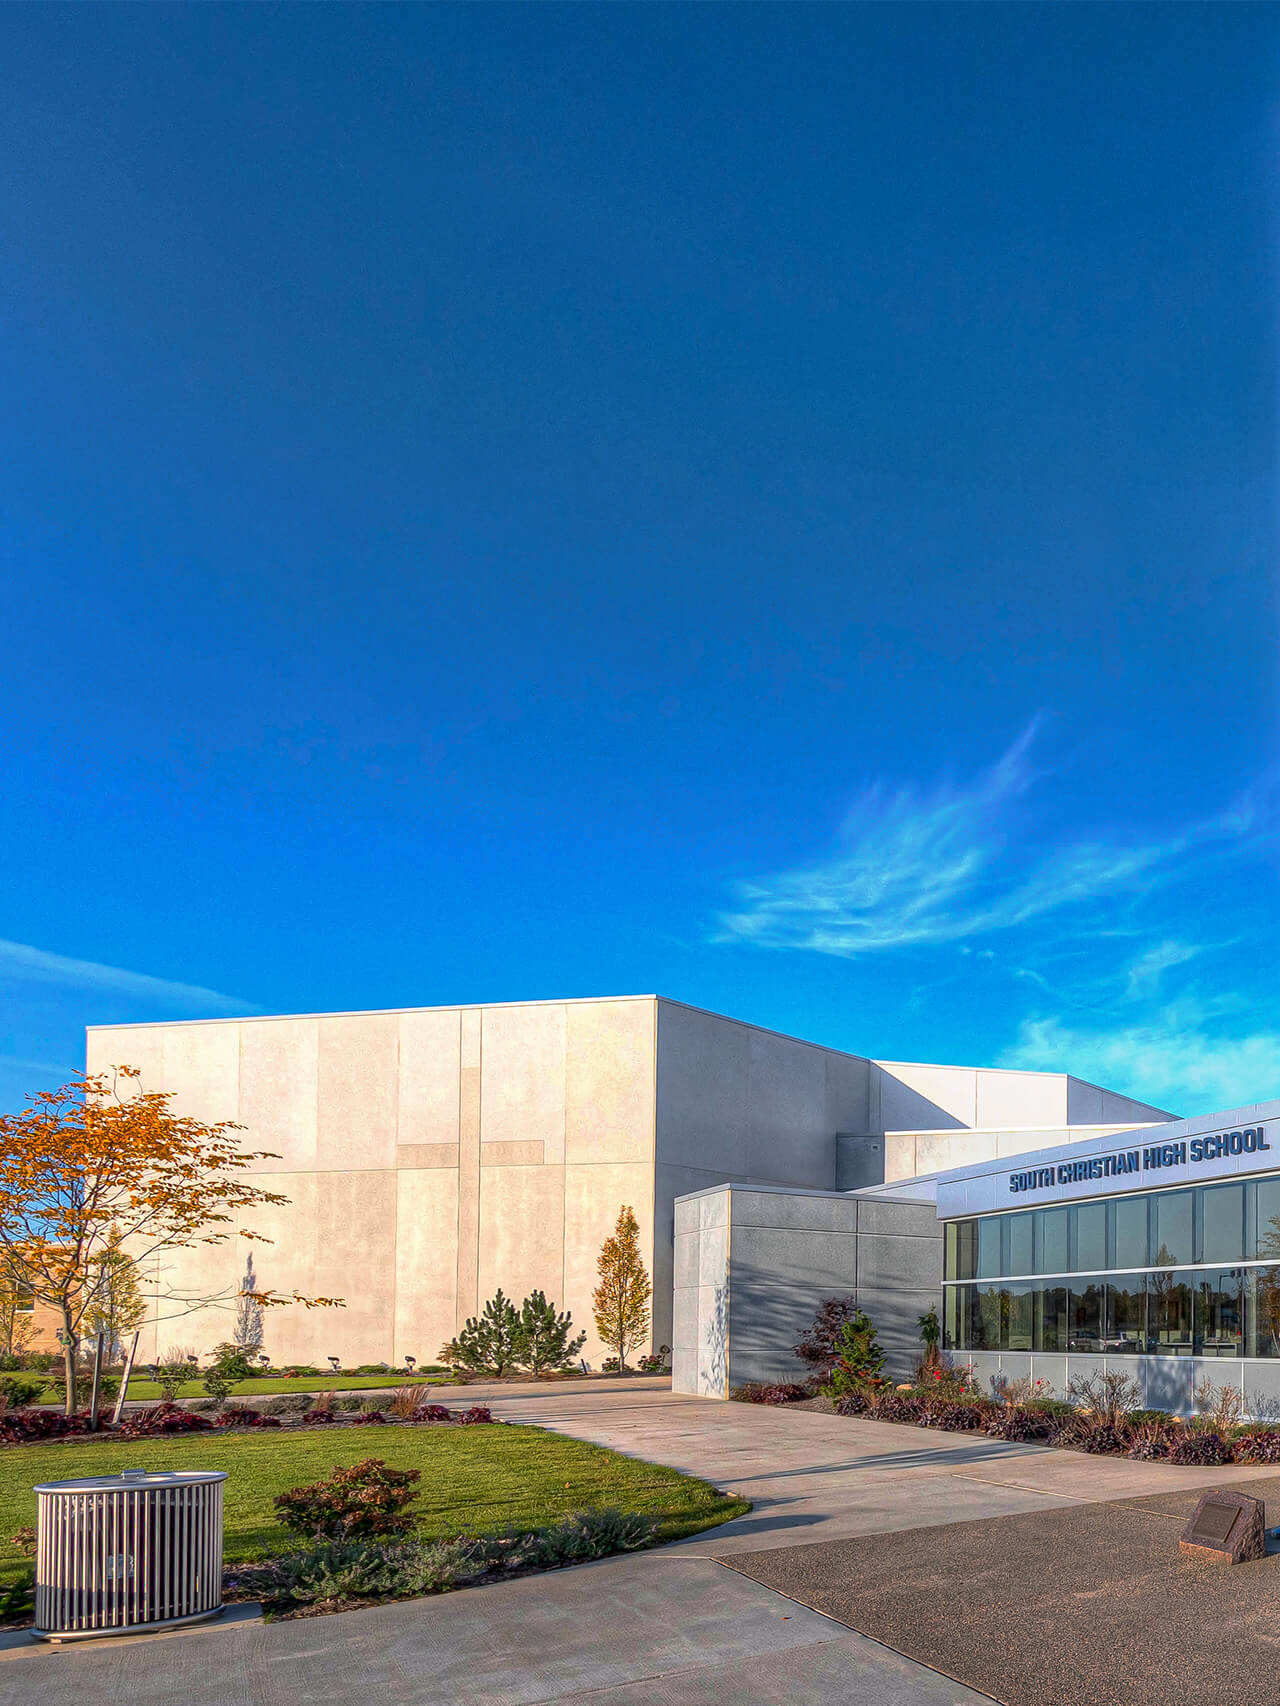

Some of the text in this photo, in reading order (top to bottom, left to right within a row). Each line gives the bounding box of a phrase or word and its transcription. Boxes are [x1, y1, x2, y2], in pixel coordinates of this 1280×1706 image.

[1009, 1127, 1270, 1193] SOUTH CHRISTIAN HIGH SCHOOL
